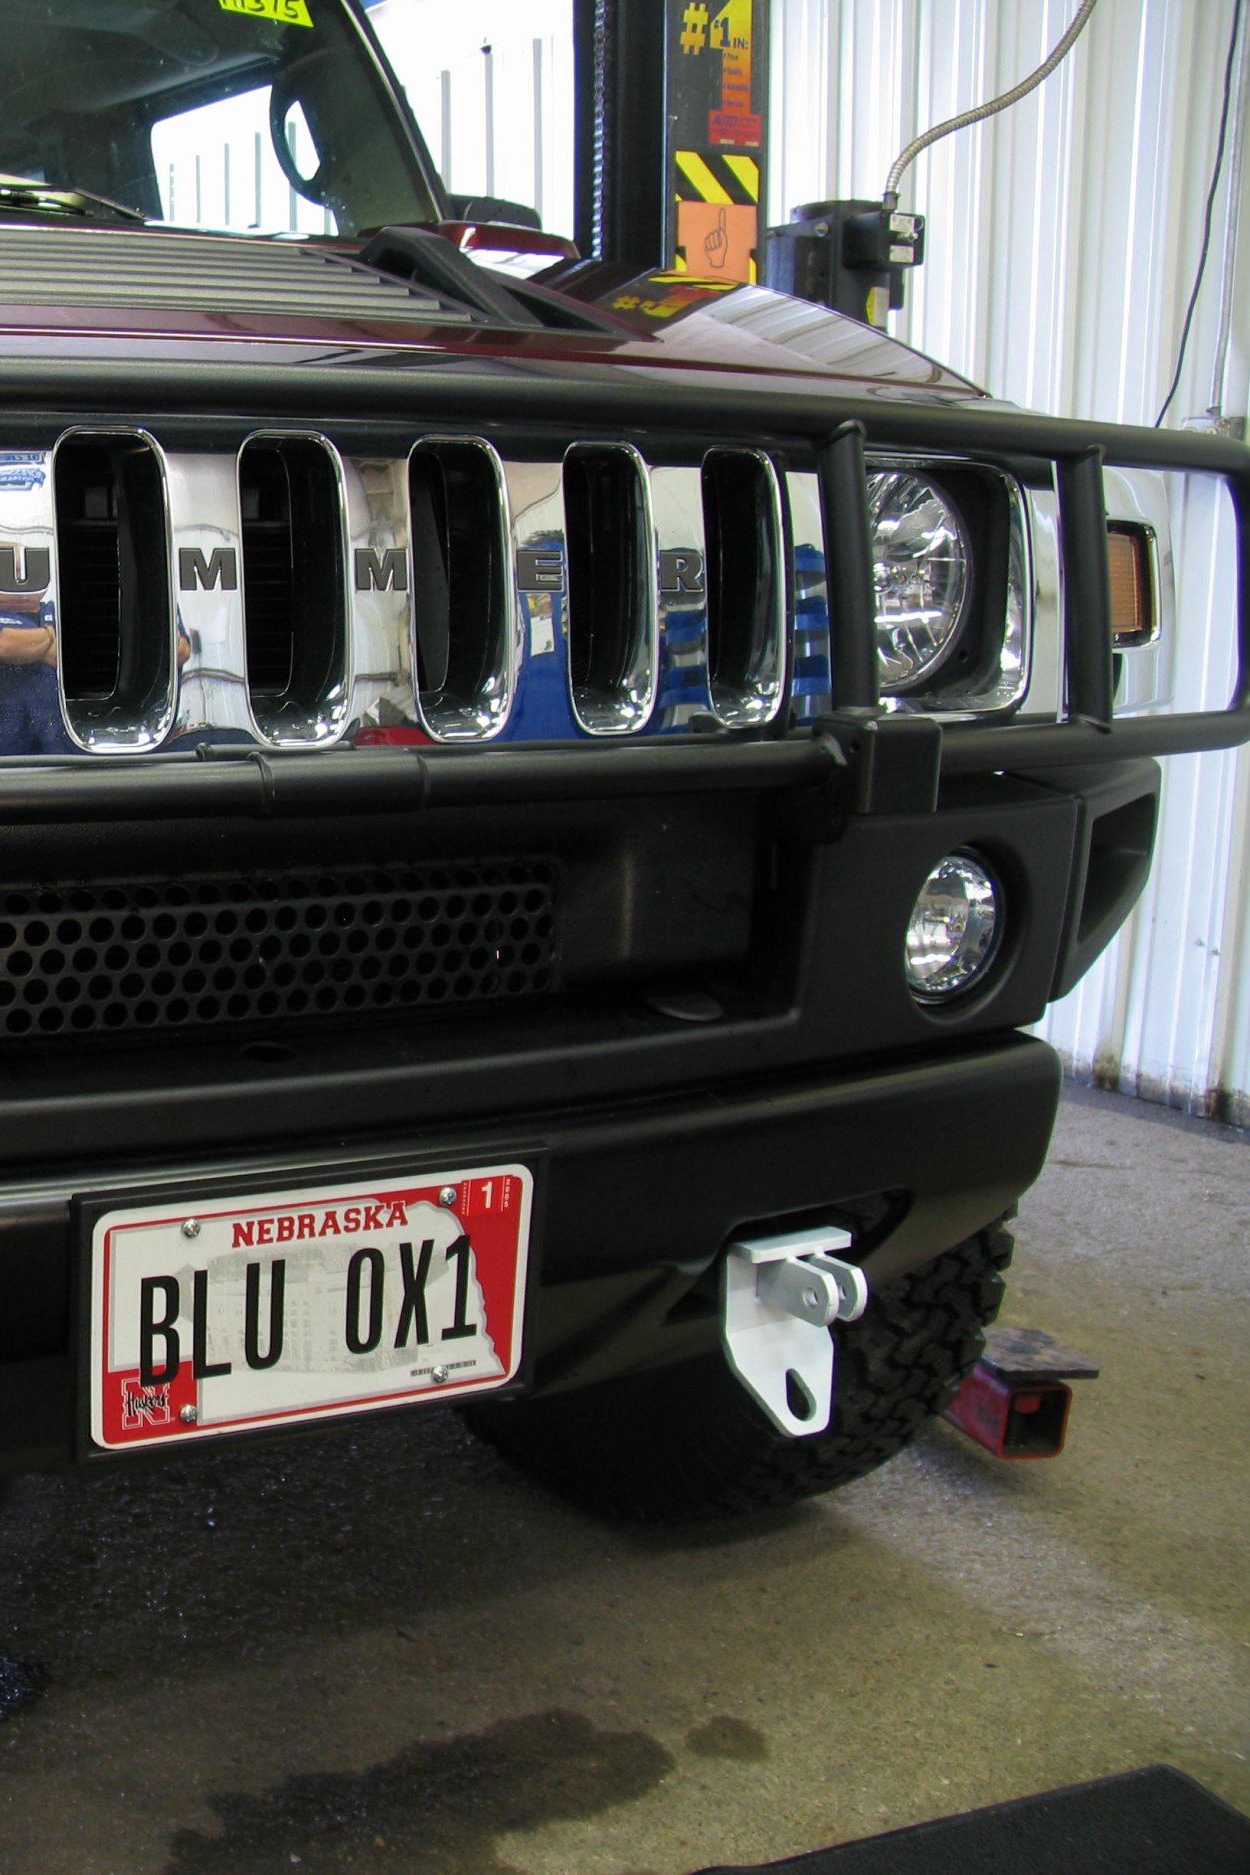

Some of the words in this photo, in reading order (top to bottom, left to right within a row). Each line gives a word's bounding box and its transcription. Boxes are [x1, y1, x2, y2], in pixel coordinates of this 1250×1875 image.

[733, 37, 749, 50] IN:
[481, 1181, 493, 1209] 1
[232, 1201, 409, 1248] NEBRASKA
[140, 1259, 286, 1388] BLU
